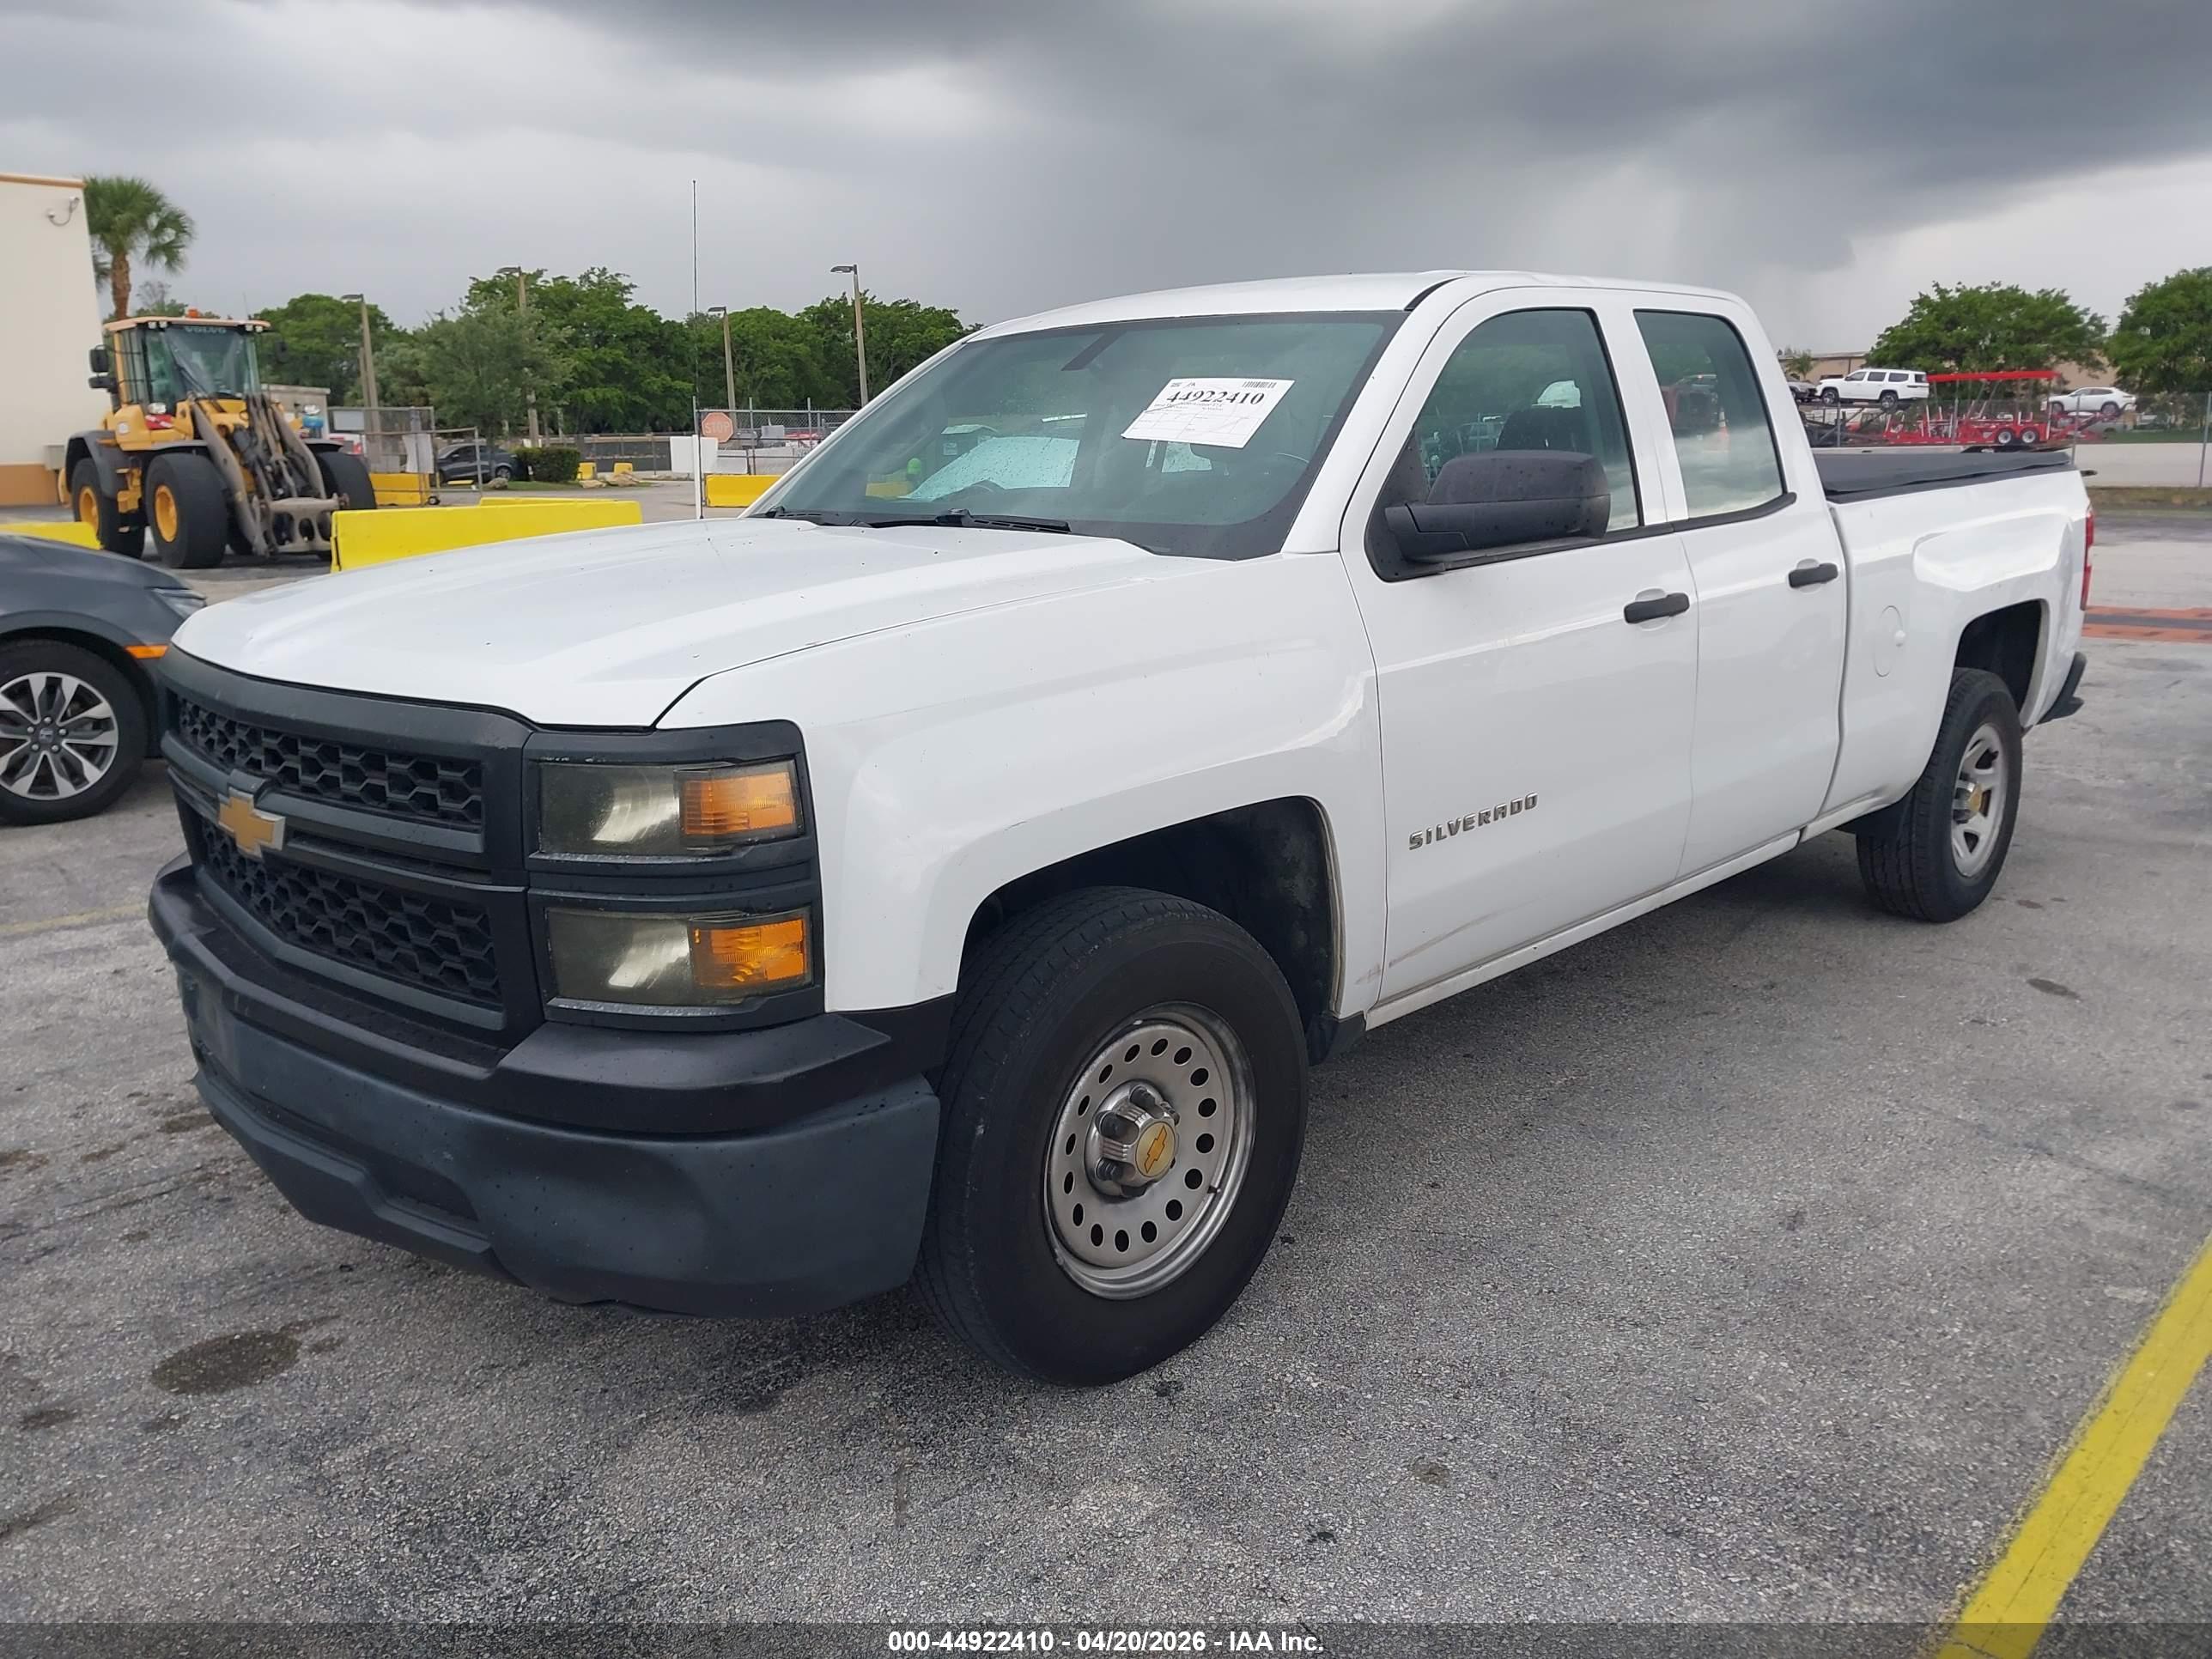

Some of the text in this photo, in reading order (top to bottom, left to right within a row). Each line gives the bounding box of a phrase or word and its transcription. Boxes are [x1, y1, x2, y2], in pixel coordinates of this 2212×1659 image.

[1166, 390, 1265, 404] 44922410
[704, 421, 731, 434] STOP
[1408, 792, 1539, 851] SILVERADO
